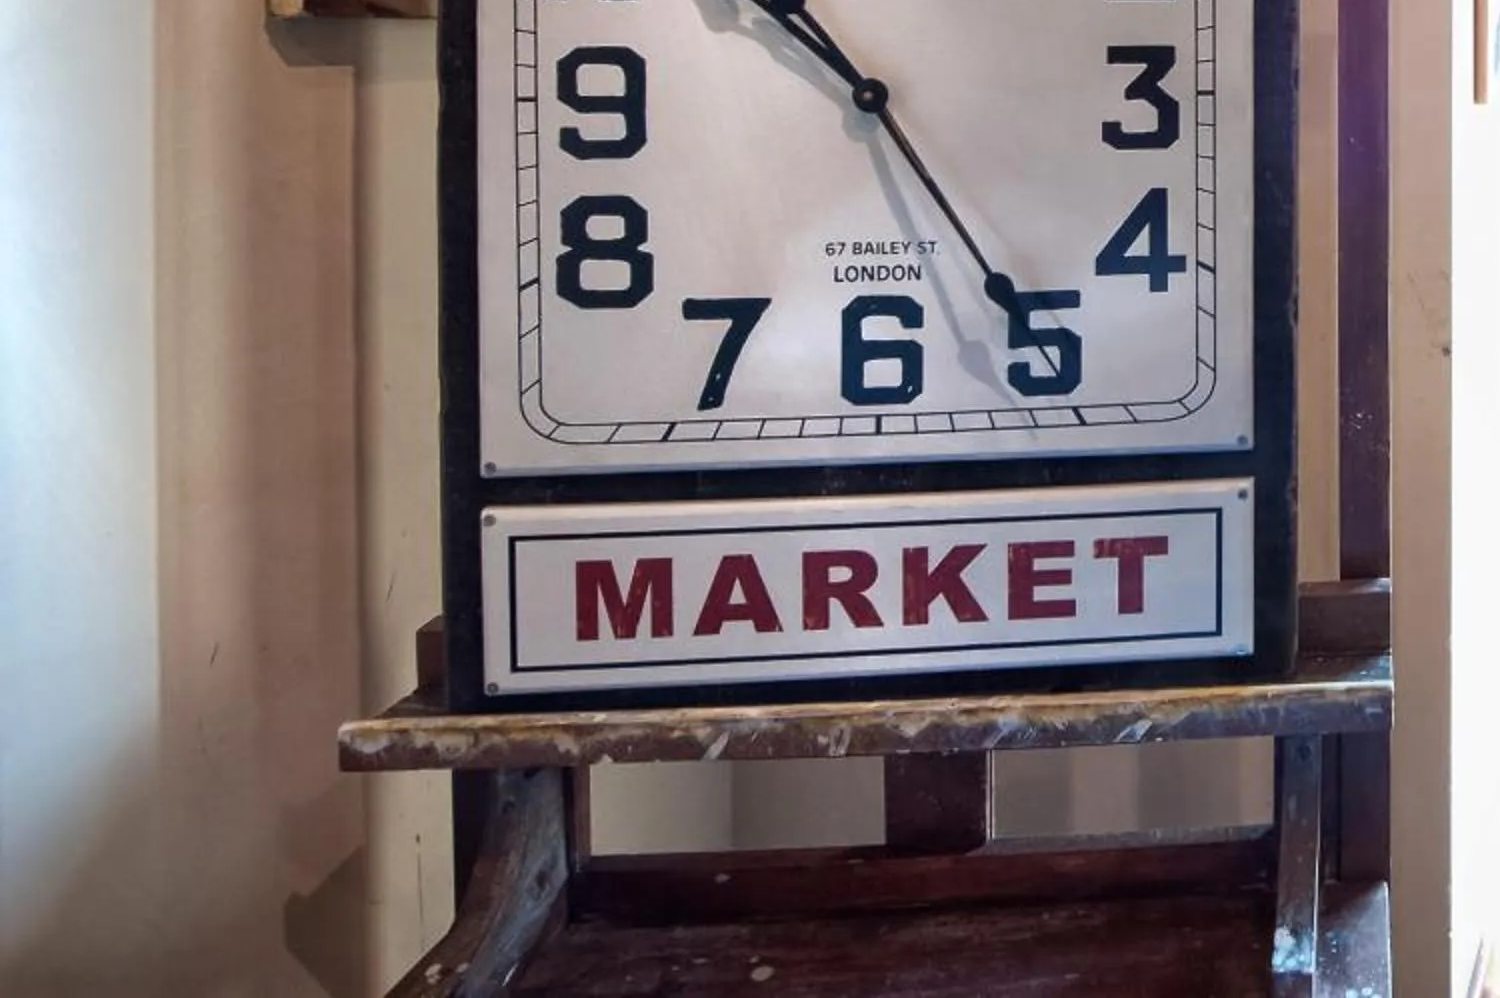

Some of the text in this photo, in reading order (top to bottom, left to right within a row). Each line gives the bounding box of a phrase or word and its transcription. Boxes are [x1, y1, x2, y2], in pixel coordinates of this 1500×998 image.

[557, 46, 647, 160] 9
[1102, 45, 1179, 150] 3
[556, 195, 654, 309] 8
[826, 242, 846, 256] 67
[852, 241, 911, 255] BAILEY
[834, 265, 921, 282] LONDON
[1096, 188, 1186, 292] 4
[682, 298, 772, 411] 7
[841, 295, 924, 406] 6
[1007, 289, 1082, 396] 5
[575, 535, 1169, 642] MARKET
